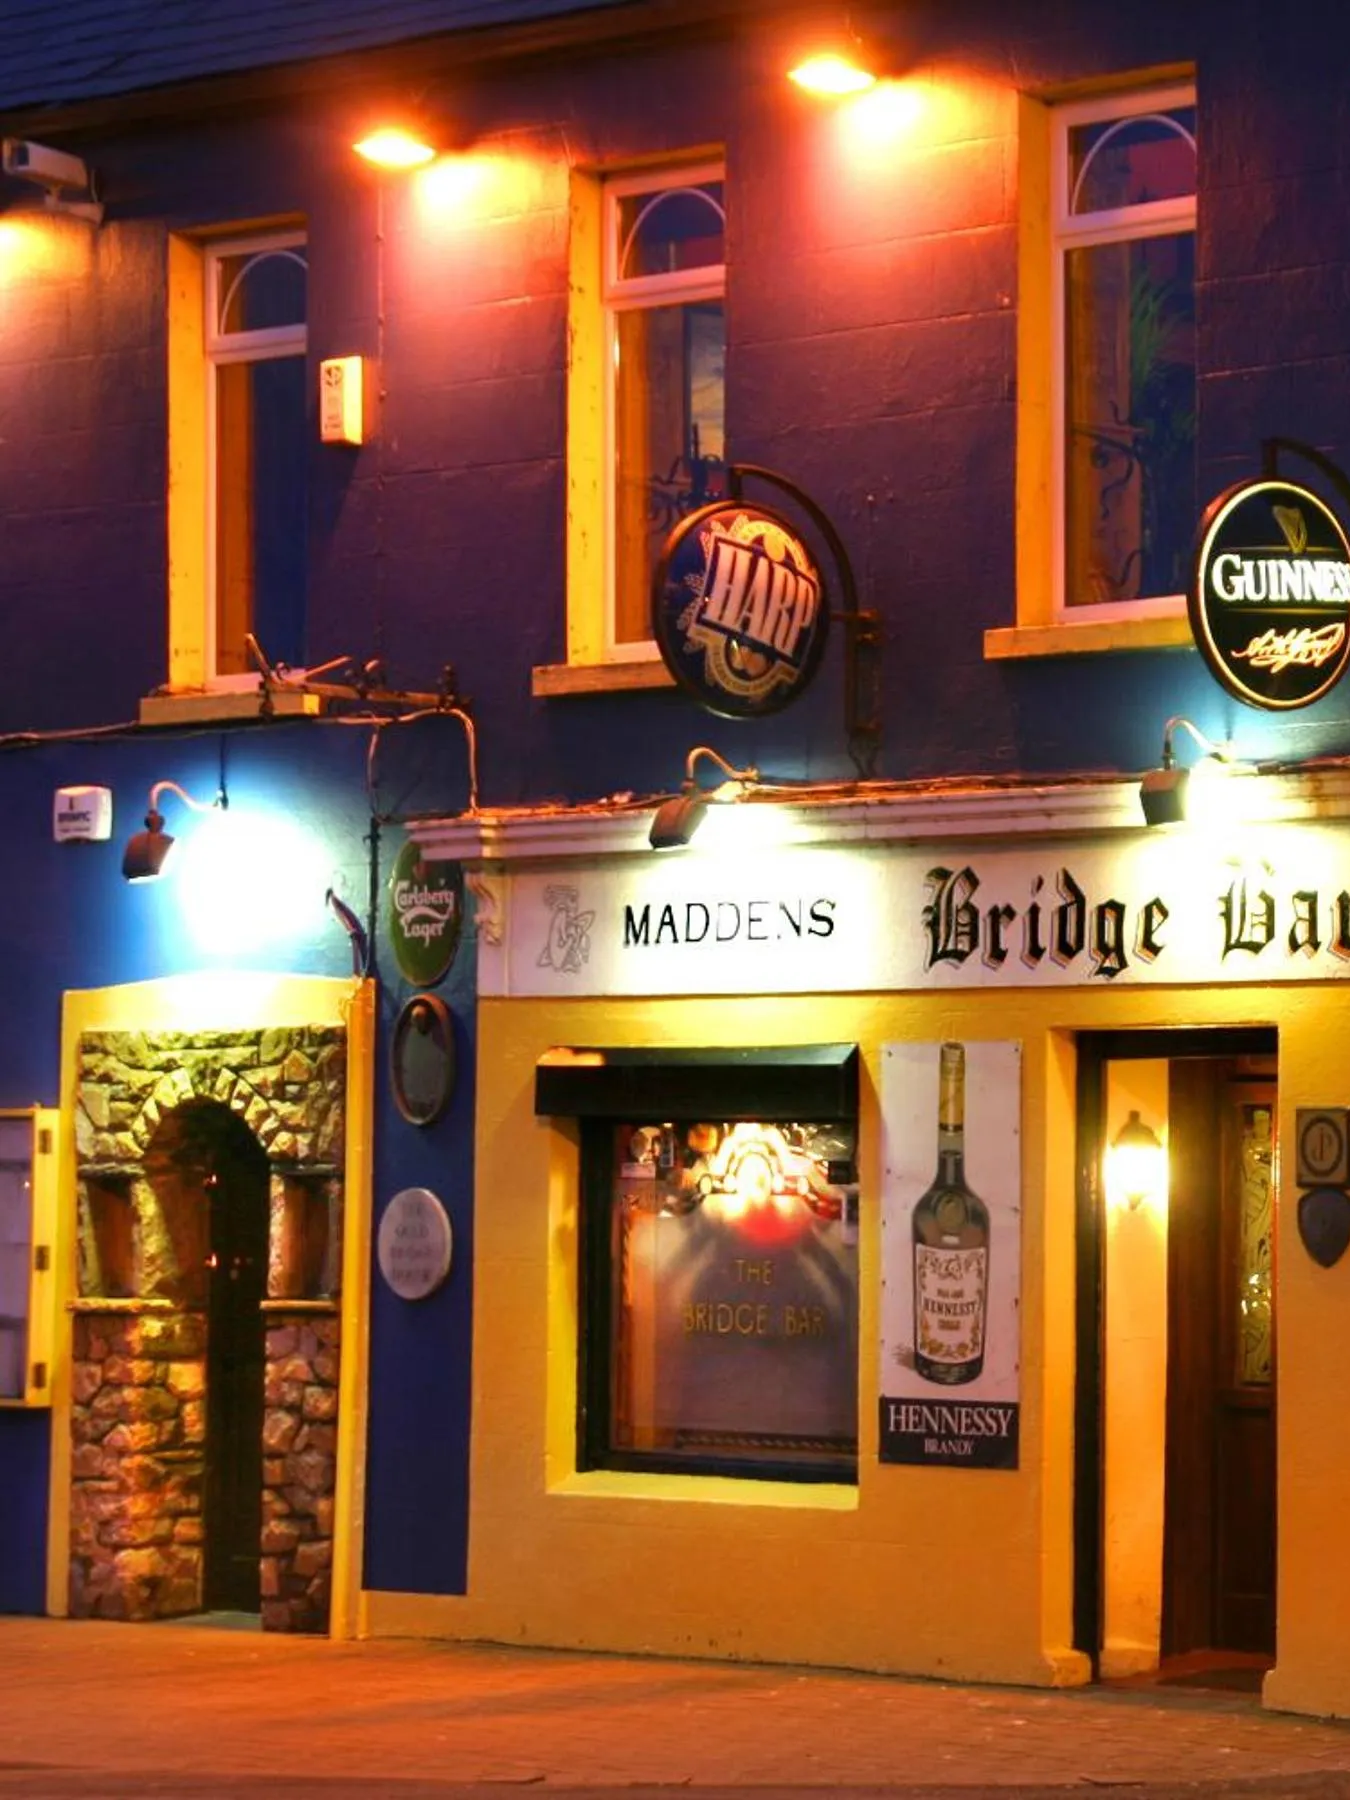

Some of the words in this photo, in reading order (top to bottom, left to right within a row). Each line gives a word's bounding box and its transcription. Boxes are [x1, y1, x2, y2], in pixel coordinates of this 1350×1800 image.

[705, 541, 817, 660] HARP
[394, 879, 456, 919] Carlsberg
[402, 916, 445, 948] Lager
[623, 897, 837, 948] MADDENS
[922, 866, 1170, 979] Bridge
[735, 1258, 775, 1286] THE
[682, 1302, 769, 1338] BRIDGE
[784, 1304, 826, 1338] BAR
[888, 1404, 1014, 1436] HENNESSY
[924, 1438, 975, 1455] BRANDY
